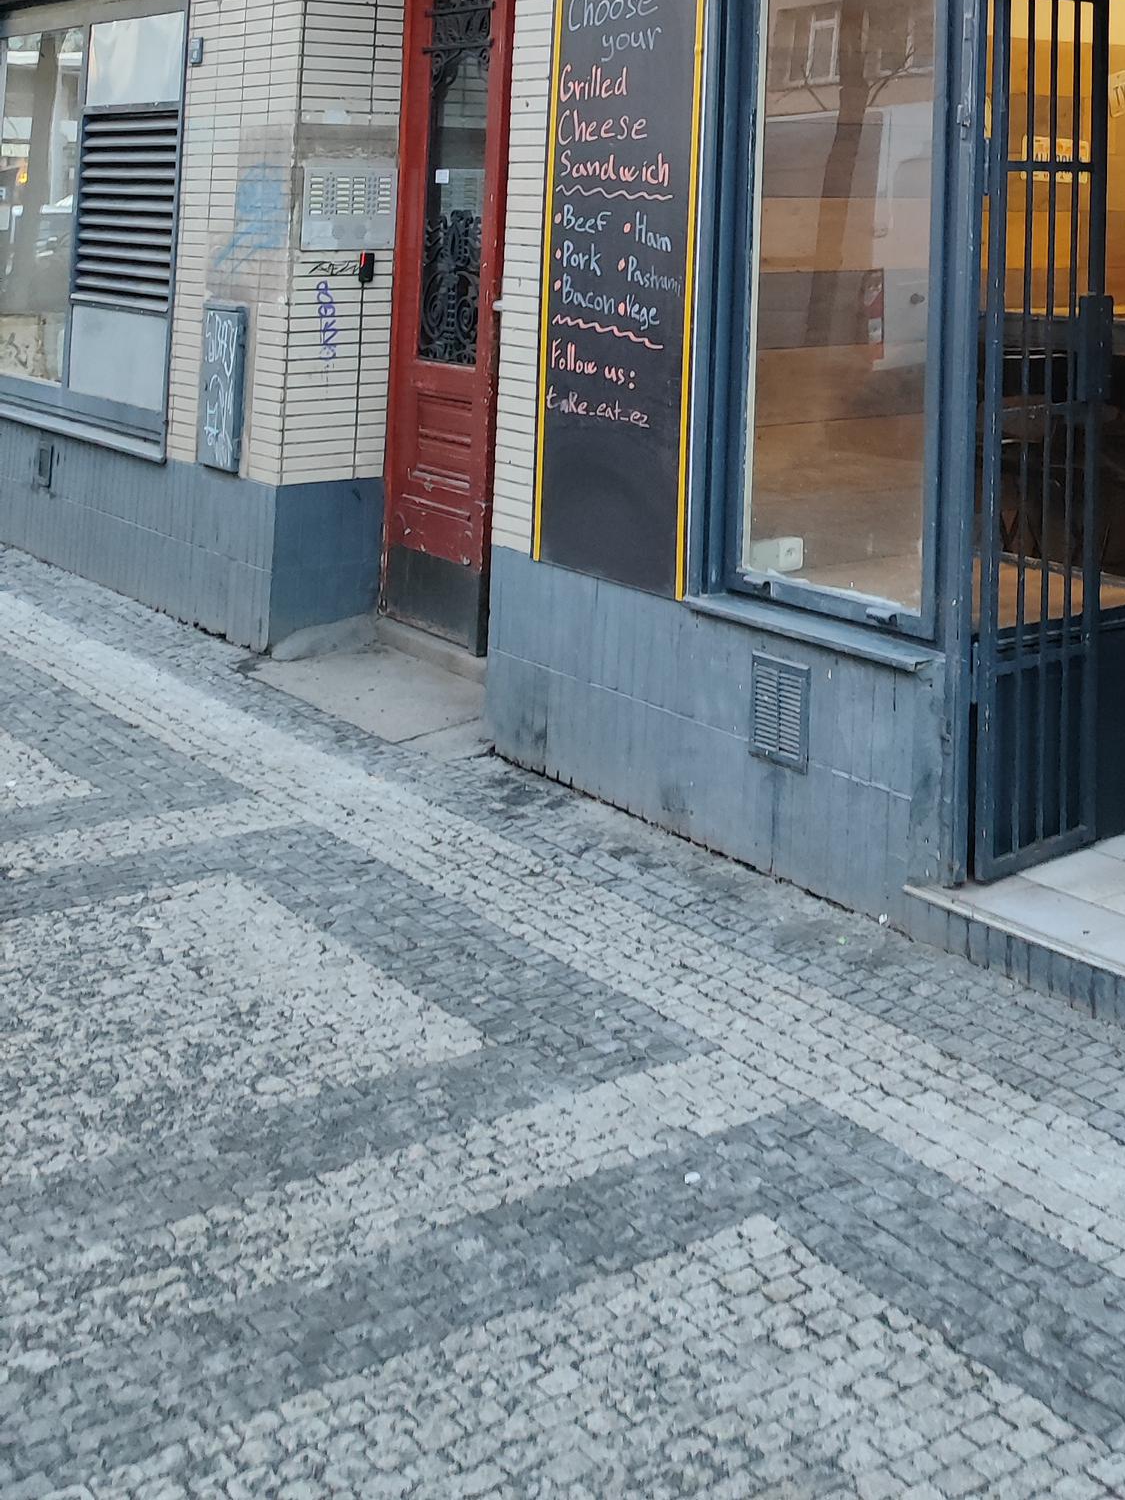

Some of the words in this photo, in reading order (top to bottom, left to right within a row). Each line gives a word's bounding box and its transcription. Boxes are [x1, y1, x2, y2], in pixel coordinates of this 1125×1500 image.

[600, 26, 663, 62] your
[558, 63, 629, 103] Grilled
[557, 109, 648, 147] Cheese
[559, 149, 670, 188] Sandwich
[634, 210, 673, 253] Ham
[562, 240, 603, 277] Pork
[625, 255, 683, 297] Pastrami
[561, 272, 616, 316] Bacon
[625, 293, 661, 332] Vege
[550, 338, 597, 375] Follow
